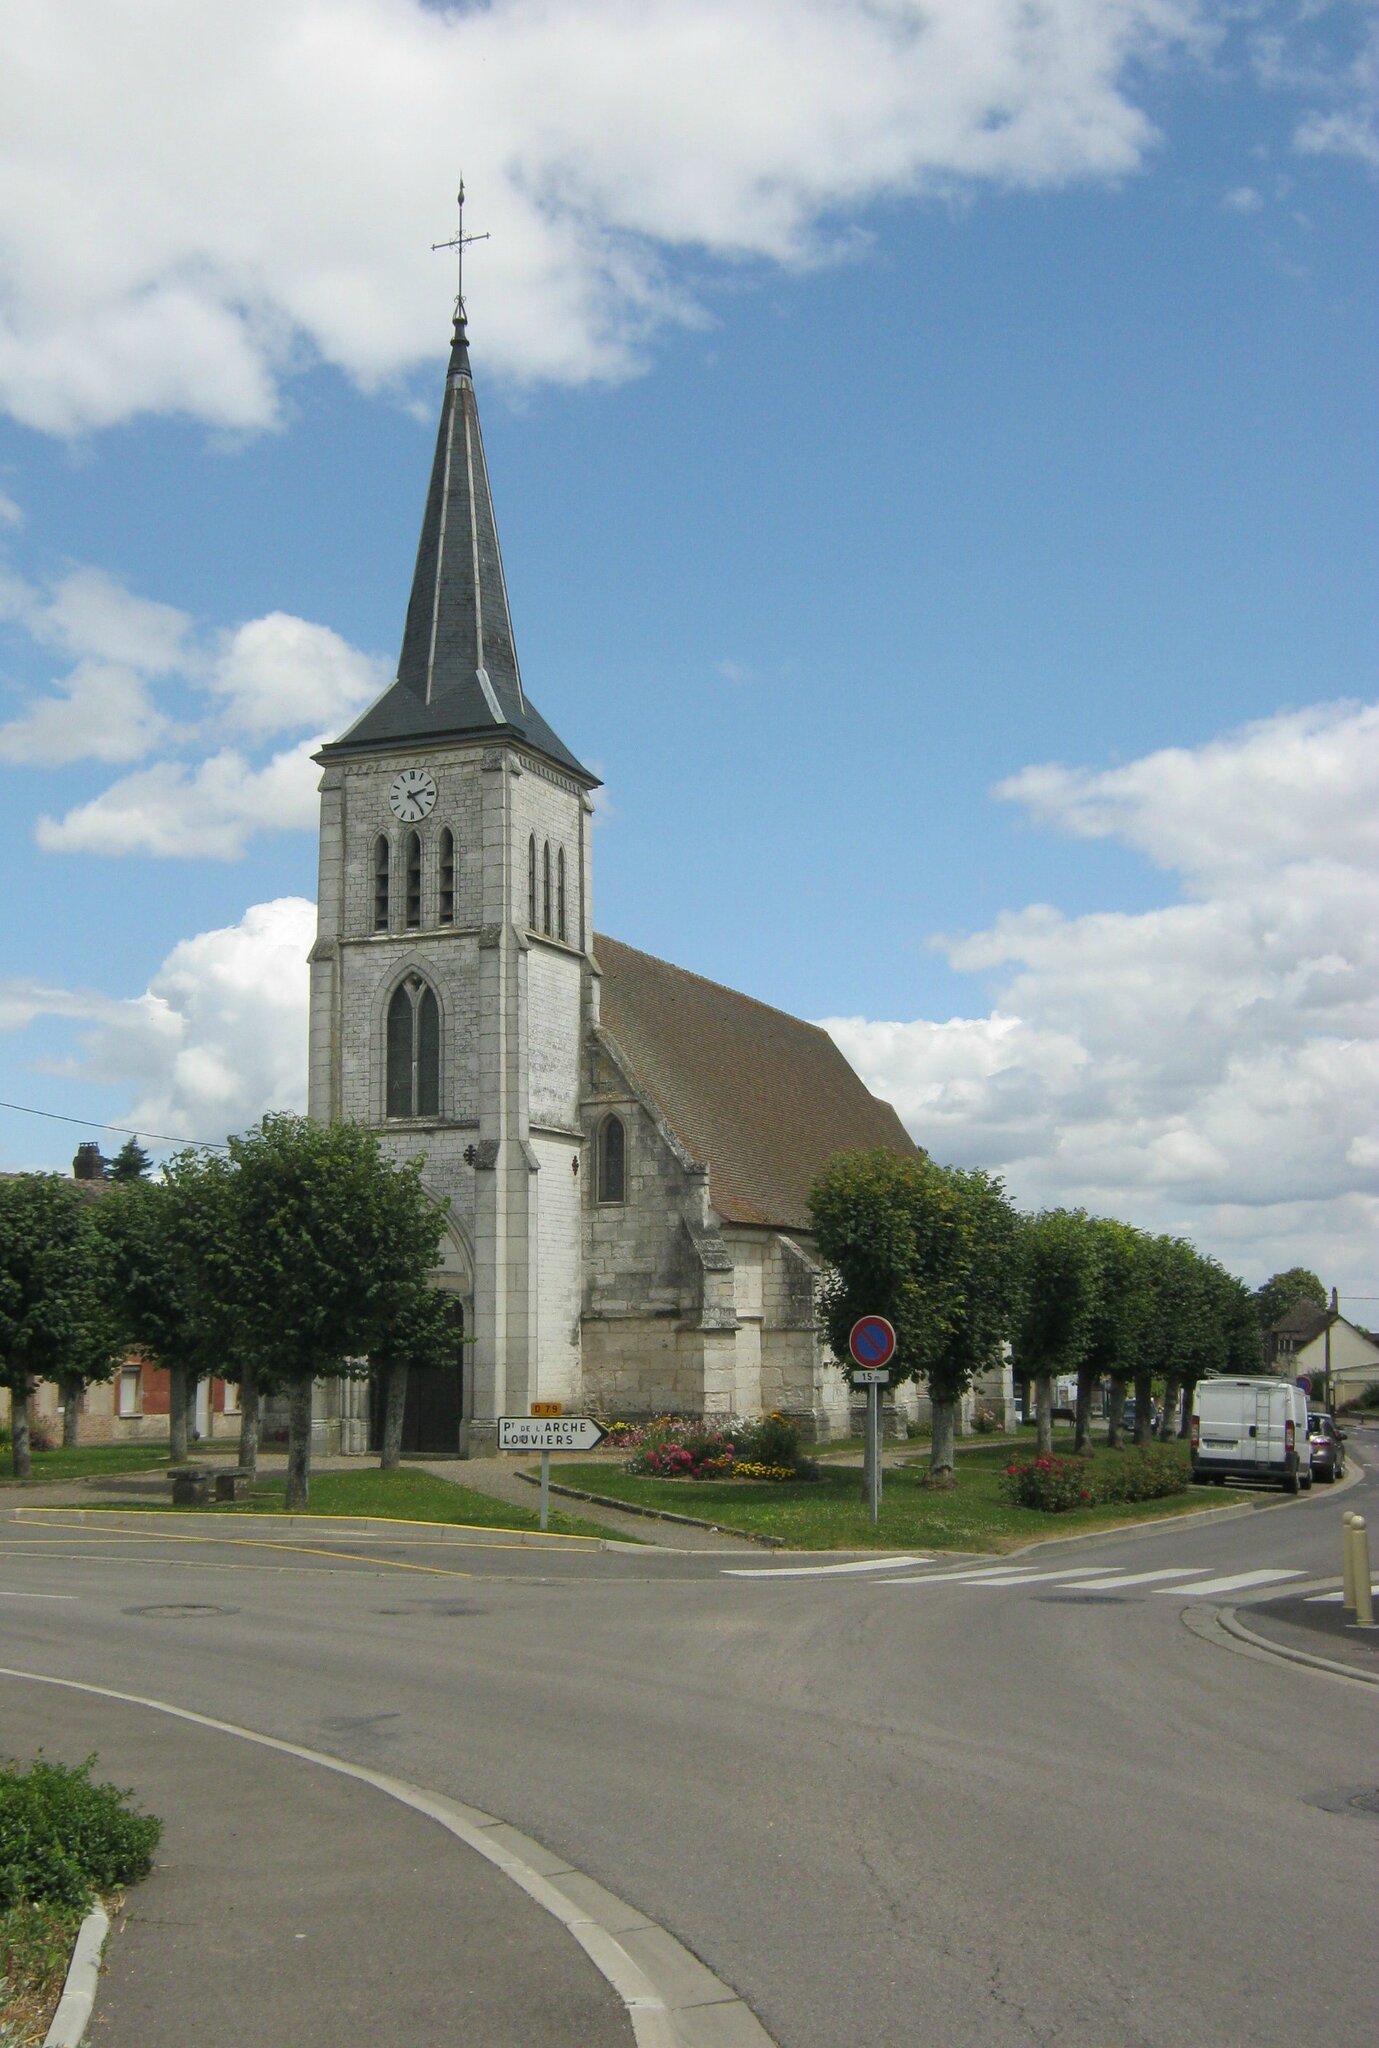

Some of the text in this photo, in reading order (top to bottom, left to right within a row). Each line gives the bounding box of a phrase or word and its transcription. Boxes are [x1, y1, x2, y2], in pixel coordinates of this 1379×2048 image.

[862, 1372, 873, 1381] 15
[534, 1405, 558, 1413] D 79
[504, 1435, 573, 1445] LOUVIERS
